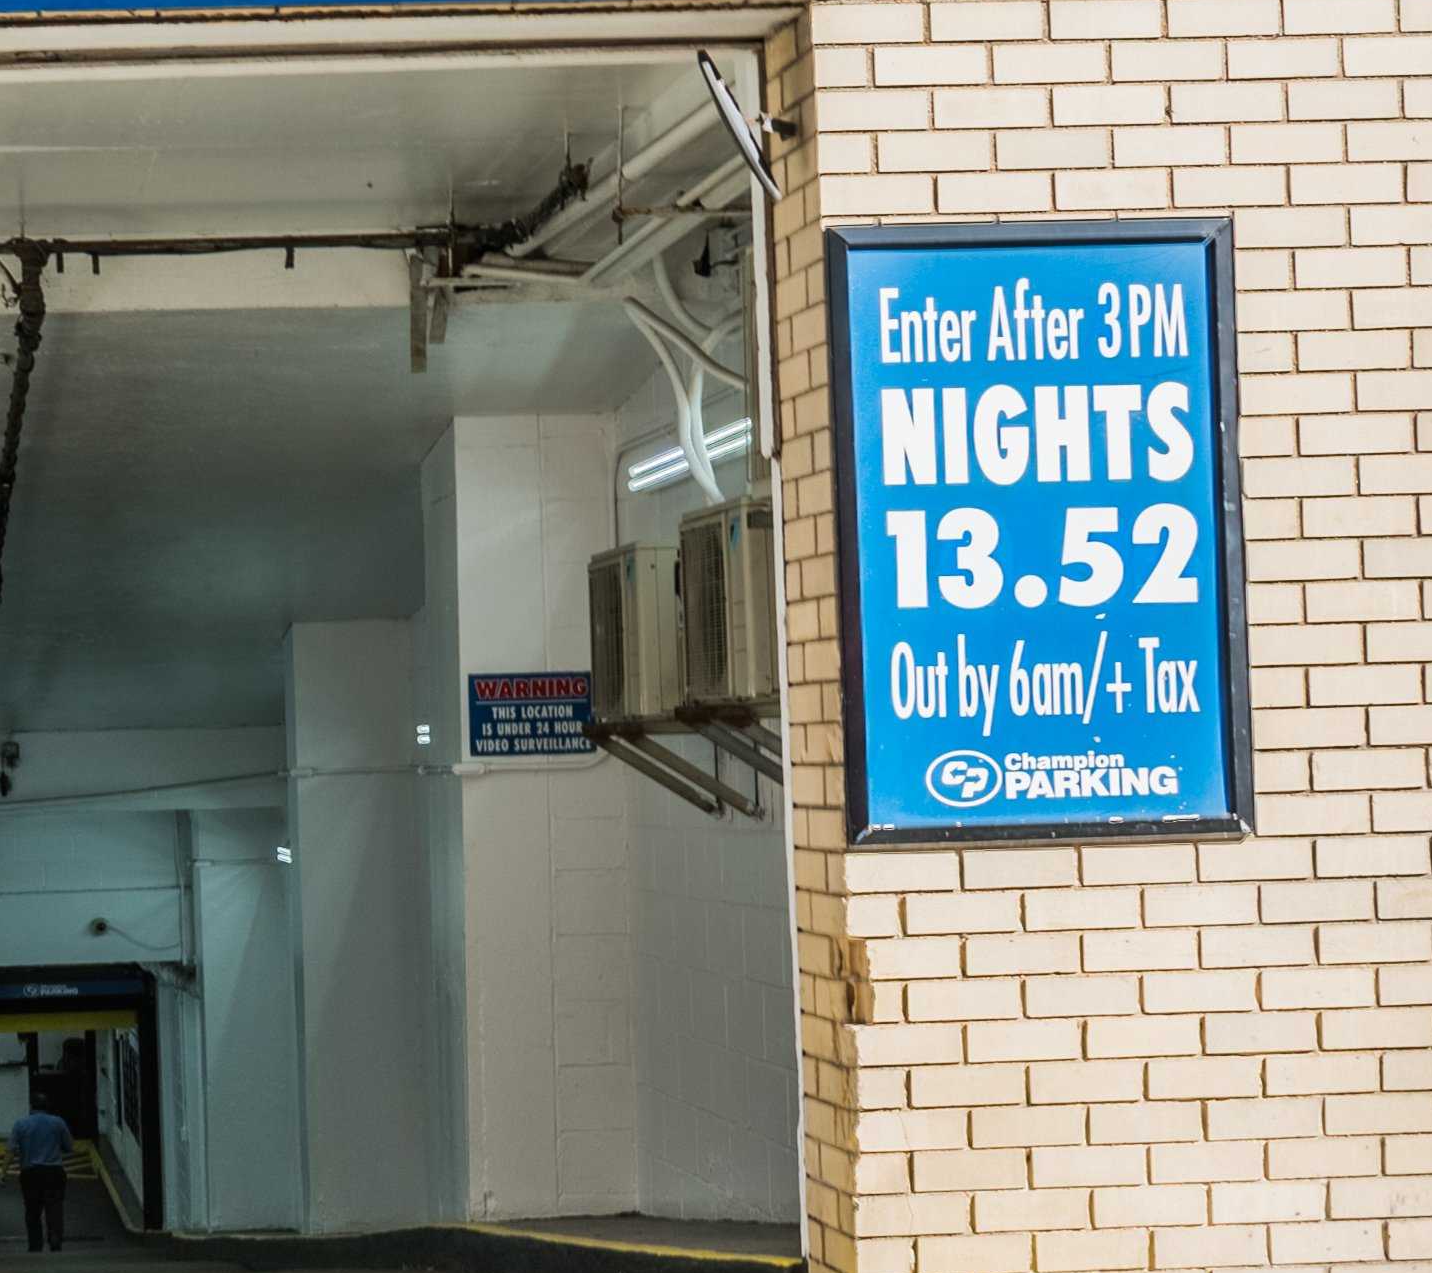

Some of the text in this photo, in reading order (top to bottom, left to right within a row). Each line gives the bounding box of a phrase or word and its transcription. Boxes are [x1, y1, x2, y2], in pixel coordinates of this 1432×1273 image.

[878, 286, 977, 364] Enter
[986, 276, 1085, 362] After
[880, 381, 1195, 487] NIGHTS
[886, 502, 1199, 609] 13.52
[474, 676, 588, 700] WARNING
[890, 640, 949, 721] Out
[956, 633, 1001, 738] by
[1138, 636, 1201, 714] Tax
[491, 705, 574, 720] THIS LOCATION
[481, 720, 583, 736] IS UNDER 24 HOUR
[475, 736, 592, 753] VIDEO SURVEILLANCE
[1004, 751, 1125, 773] Champion
[1004, 766, 1179, 800] PARKING
